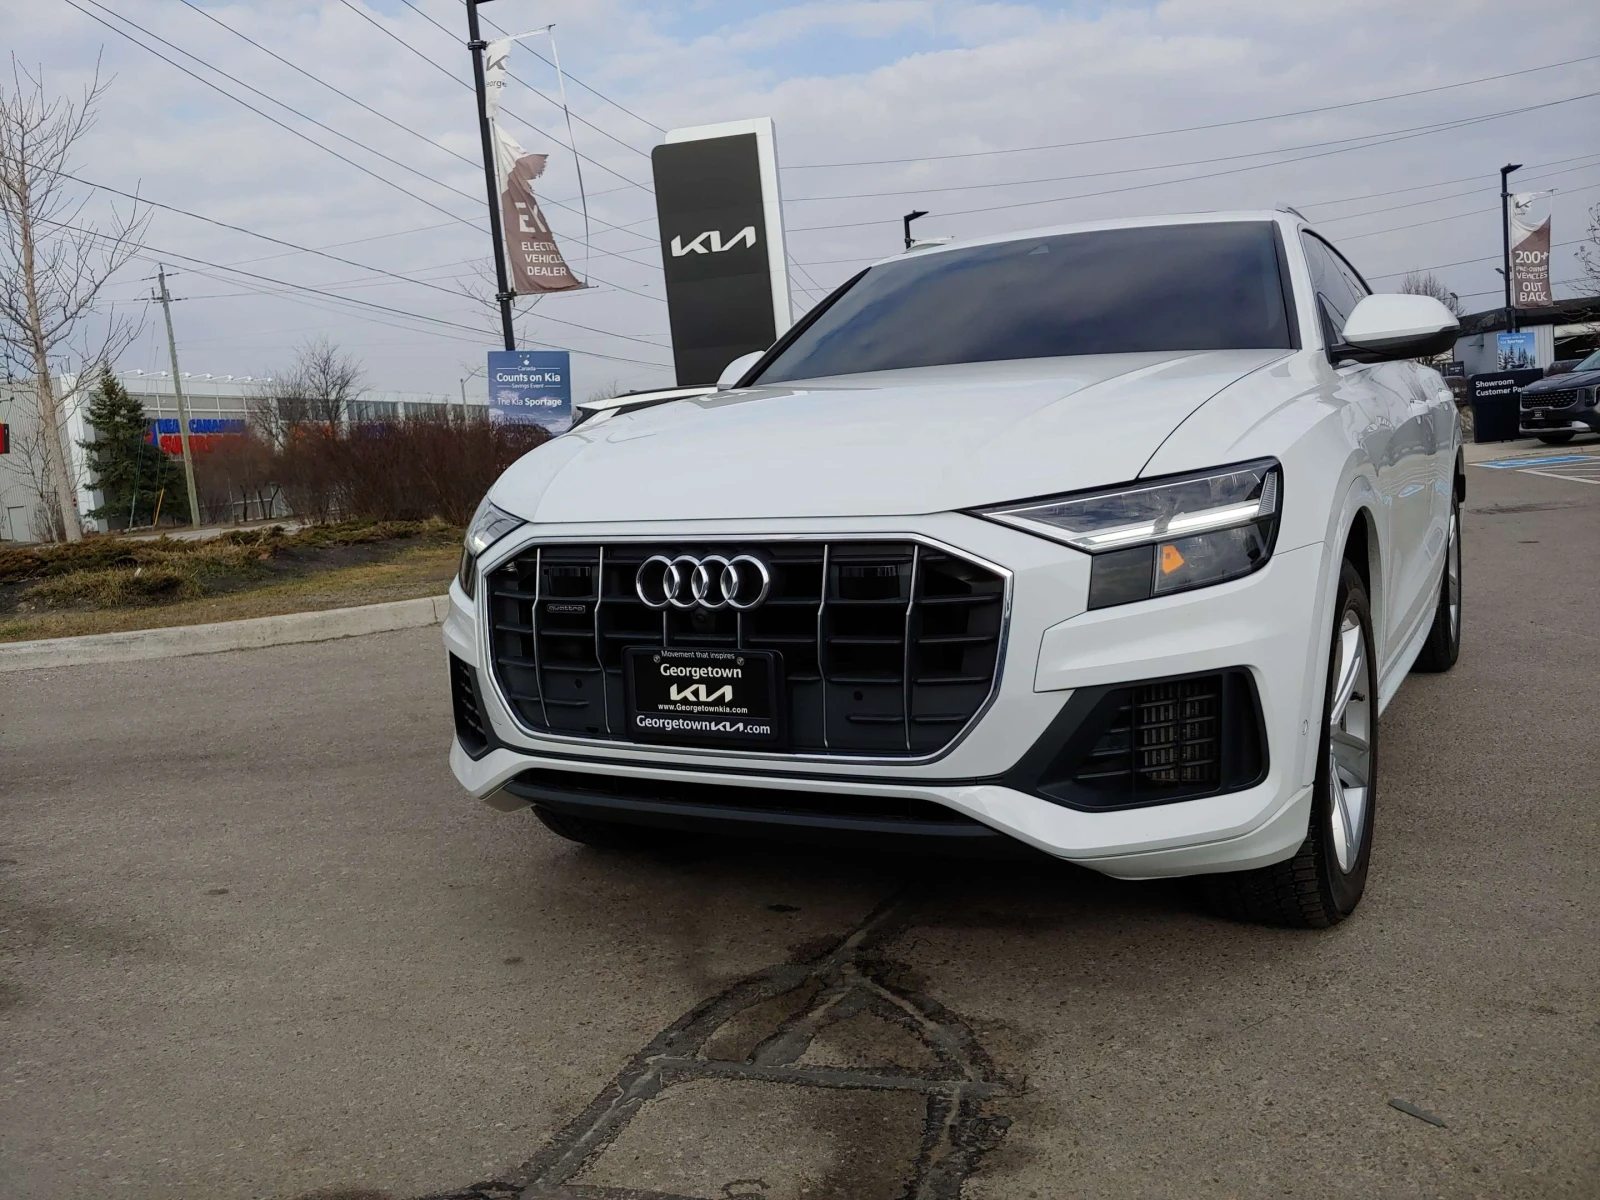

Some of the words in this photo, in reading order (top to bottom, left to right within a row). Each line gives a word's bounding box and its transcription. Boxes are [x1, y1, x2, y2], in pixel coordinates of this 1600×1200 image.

[1515, 250, 1549, 264] 200+
[527, 266, 567, 276] DEALER
[1522, 281, 1543, 292] OUT
[1519, 291, 1549, 302] BACK
[496, 372, 528, 382] Counts
[529, 374, 543, 382] on
[544, 372, 561, 382] Kia
[1475, 379, 1515, 388] Showroom
[1475, 387, 1511, 397] Customer
[497, 397, 511, 406] The
[511, 397, 524, 406] Kia
[524, 397, 563, 408] Sportage
[661, 650, 695, 658] Movement
[695, 651, 709, 659] that
[709, 651, 736, 660] inspires
[660, 663, 742, 680] Georgetown
[657, 703, 748, 714] www.Georgetownkia.com
